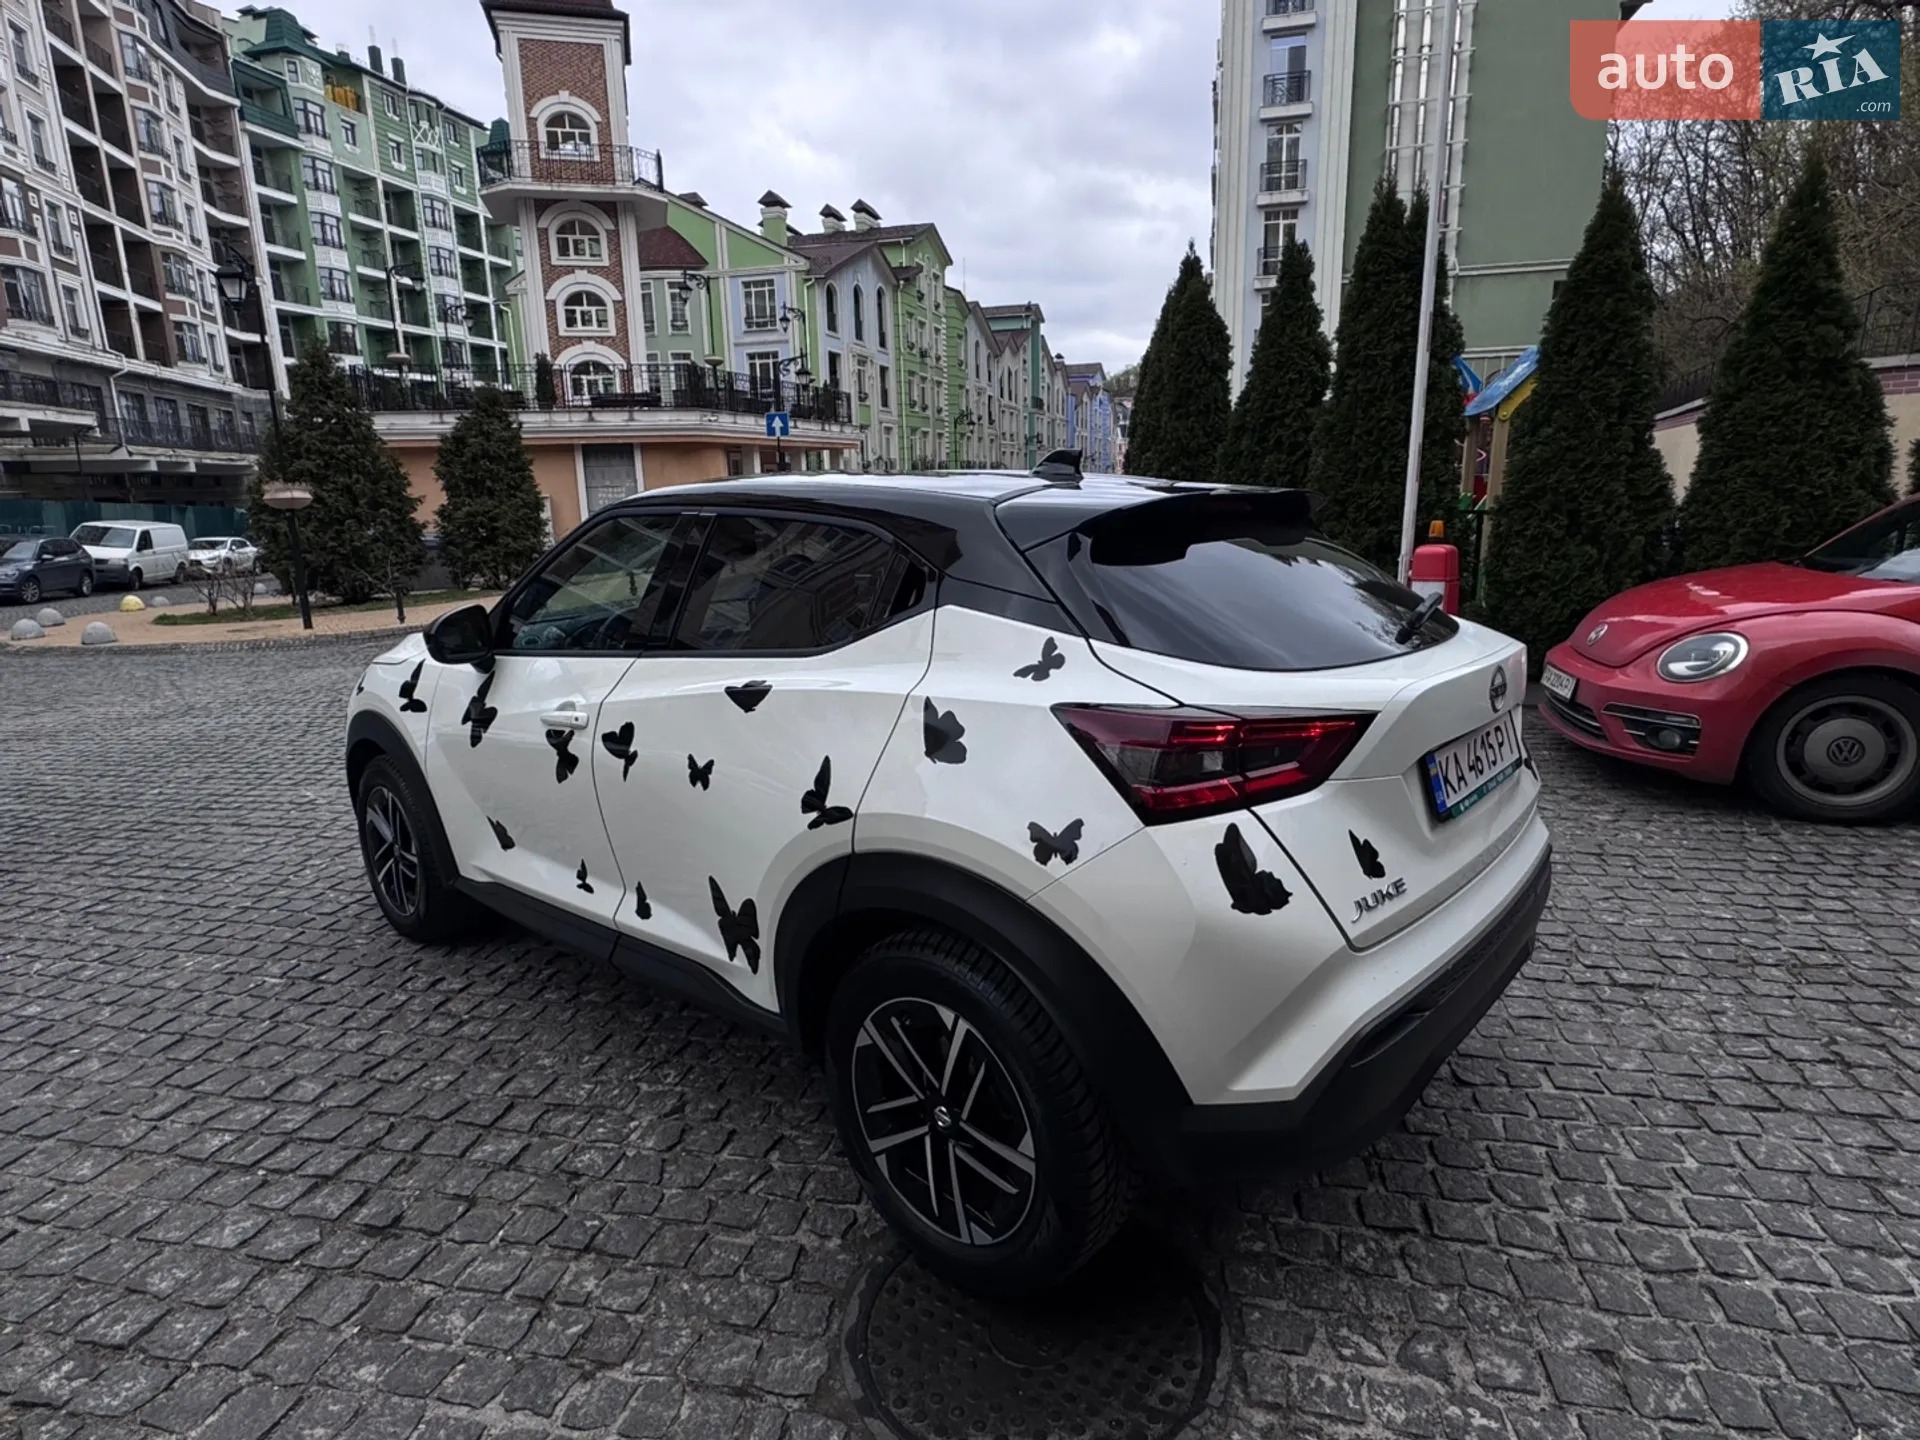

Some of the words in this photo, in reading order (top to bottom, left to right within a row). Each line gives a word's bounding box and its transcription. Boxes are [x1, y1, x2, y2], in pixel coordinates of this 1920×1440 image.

[1439, 752, 1468, 799] KA
[1467, 730, 1497, 779] 4615
[1351, 877, 1407, 923] JUKE
